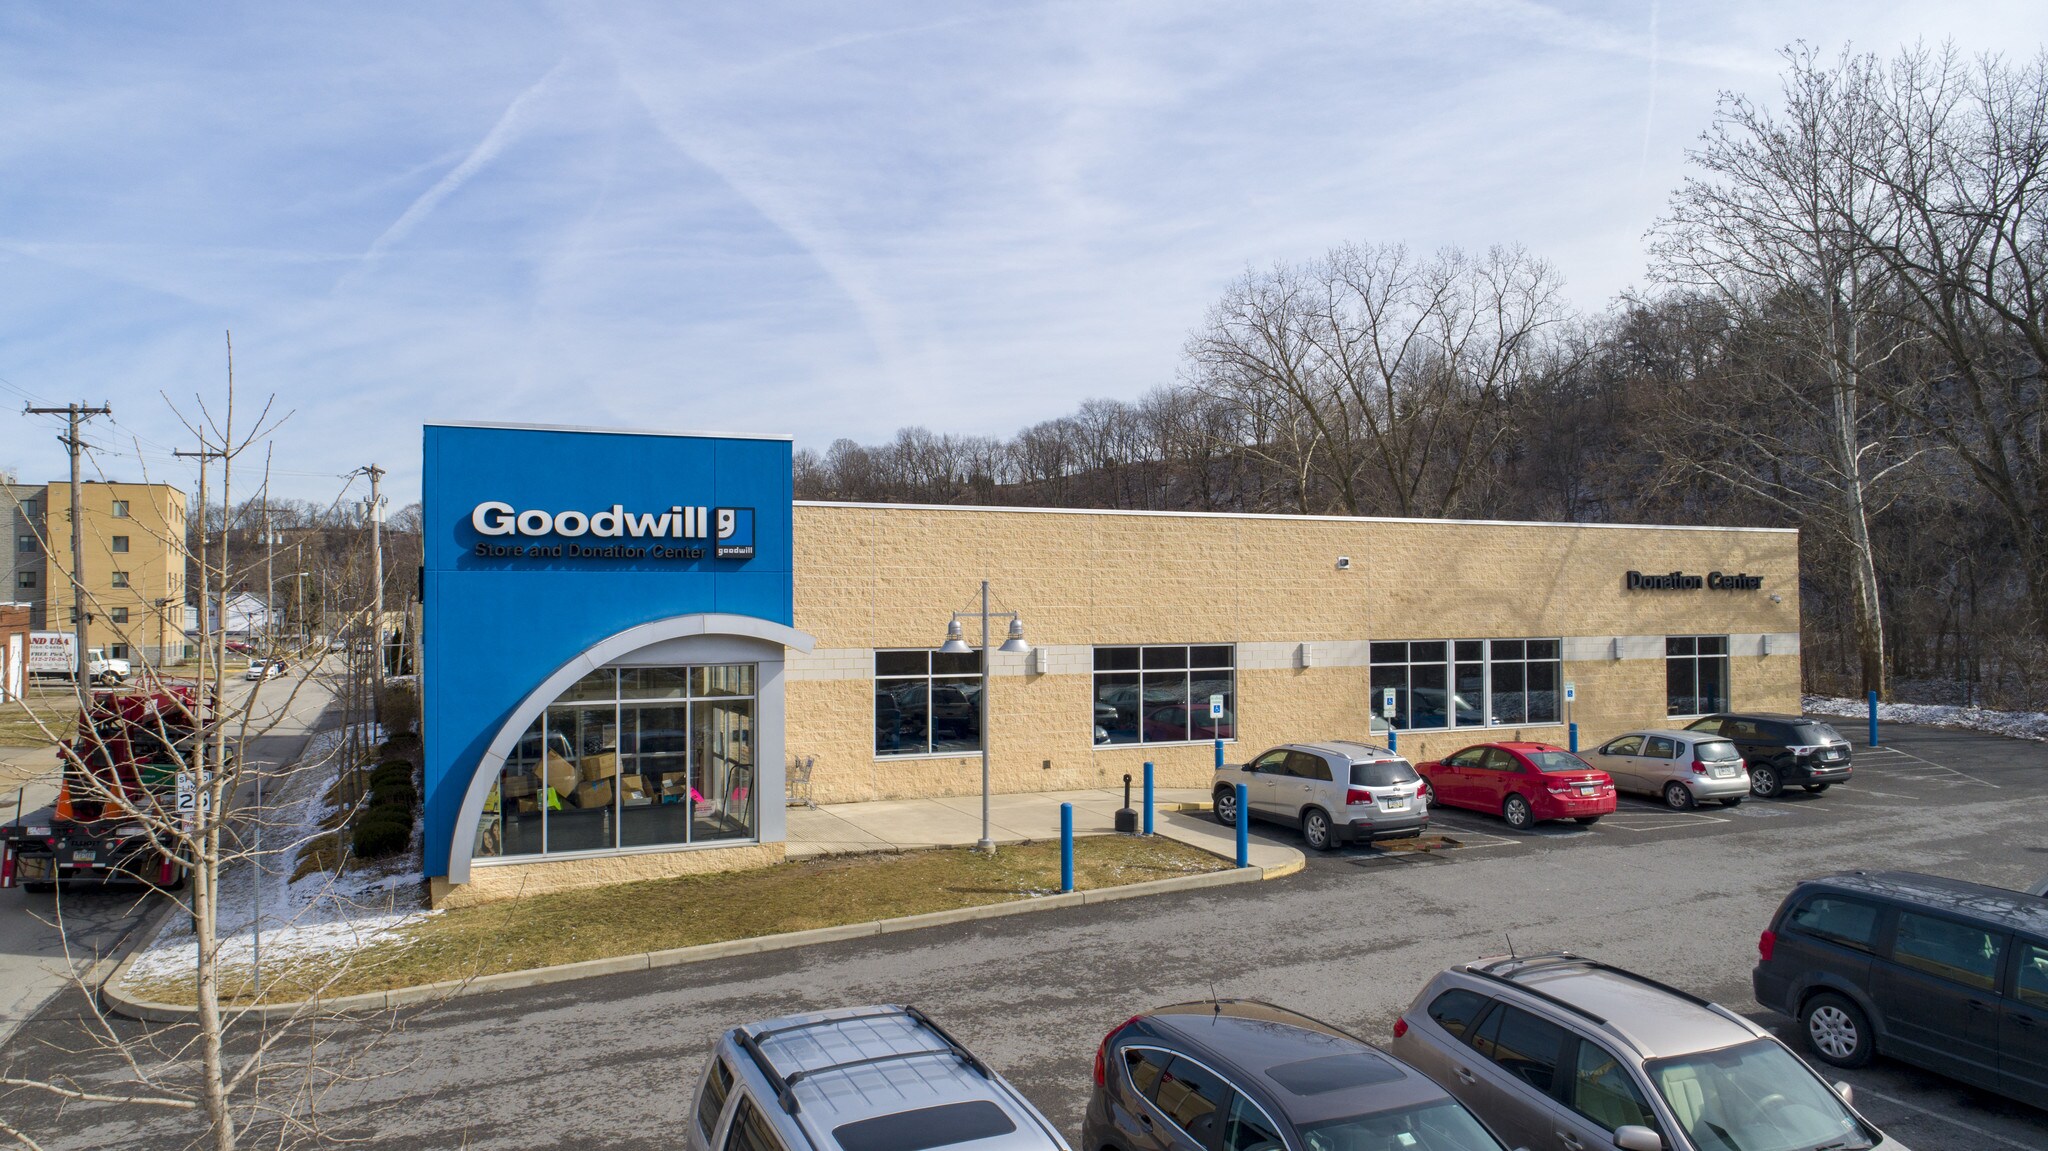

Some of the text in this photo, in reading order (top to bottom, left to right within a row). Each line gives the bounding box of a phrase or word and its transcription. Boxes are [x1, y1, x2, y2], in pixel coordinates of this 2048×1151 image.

[472, 501, 707, 538] Goodwill
[475, 542, 706, 560] Store and Donation Center
[718, 546, 753, 556] goodwill
[1627, 570, 1764, 590] Donation Center
